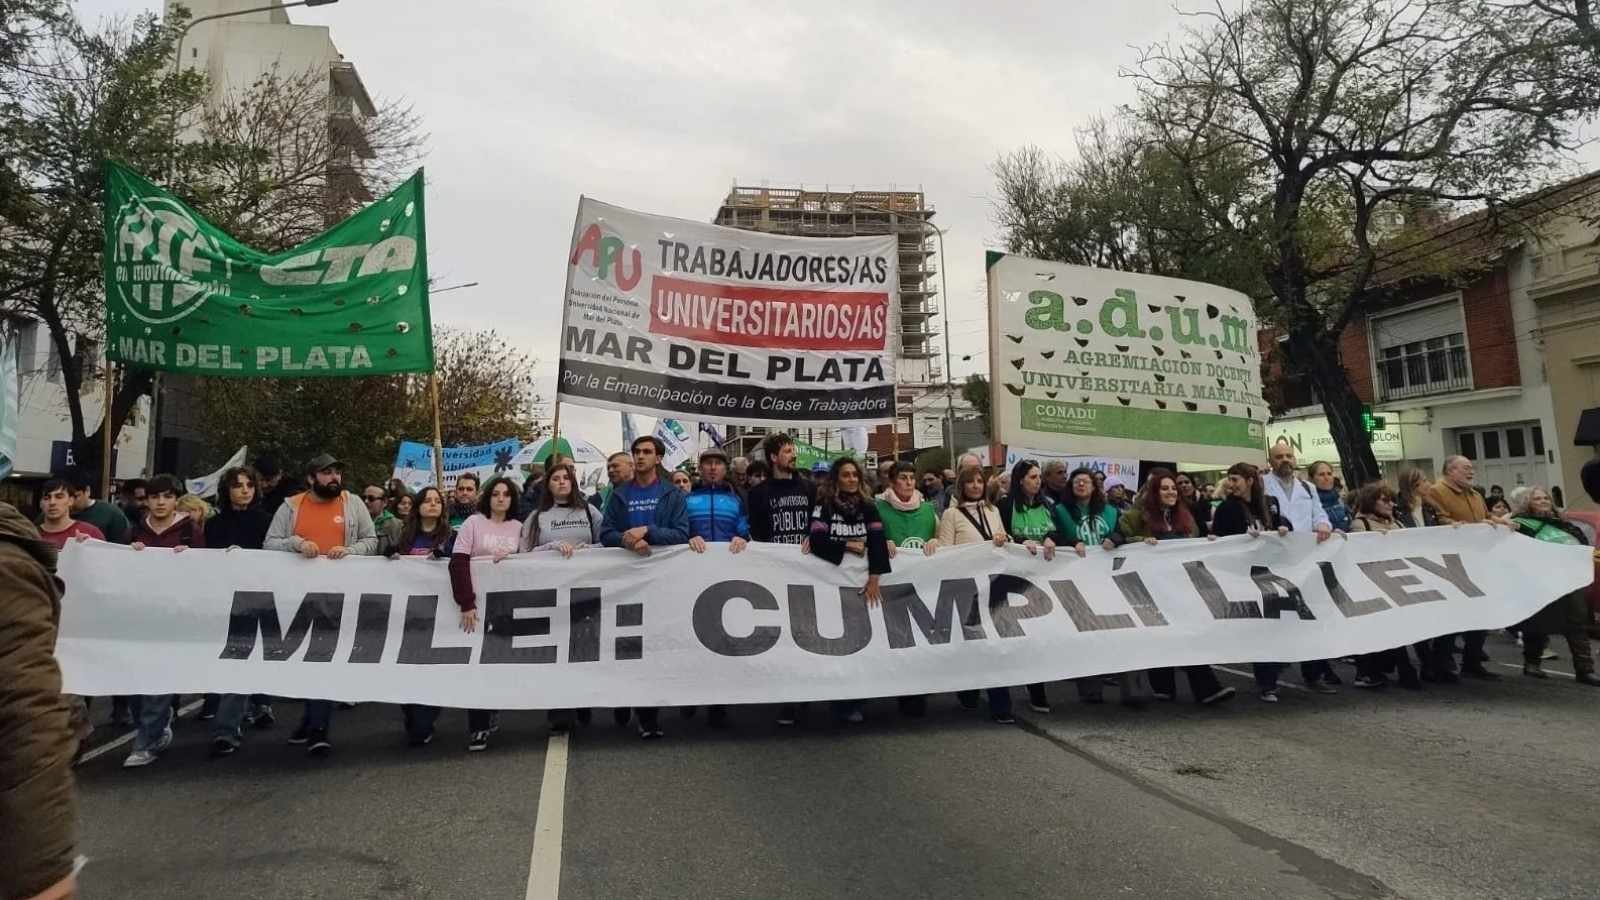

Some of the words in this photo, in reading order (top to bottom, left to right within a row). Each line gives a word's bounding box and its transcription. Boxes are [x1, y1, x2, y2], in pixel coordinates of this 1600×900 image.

[260, 236, 417, 285] CTA
[571, 224, 642, 291] APU
[658, 239, 887, 285] TRABAJADORES/AS
[657, 287, 885, 340] UNIVERSITARIOS/AS
[119, 336, 166, 365] MAR
[176, 343, 243, 369] DEL
[256, 345, 373, 370] PLATA
[566, 326, 654, 364] MAR
[668, 343, 751, 379] DEL
[766, 355, 885, 383] PLATA
[563, 370, 586, 386] Por
[586, 374, 600, 389] la
[604, 376, 713, 406] Emancipación
[717, 394, 737, 408] de
[741, 396, 755, 409] la
[760, 396, 801, 411] Clase
[808, 398, 888, 413] Trabajadora
[1021, 371, 1187, 398] UNIVERSITARIA
[1035, 404, 1096, 419] CONADU
[421, 446, 491, 459] ¡Uiversidad
[1080, 461, 1136, 475] MATERNAL
[219, 587, 643, 665] MILEI:
[692, 556, 1170, 657] CUMPLÍ
[1182, 560, 1317, 620] LA
[1315, 553, 1486, 619] LEY
